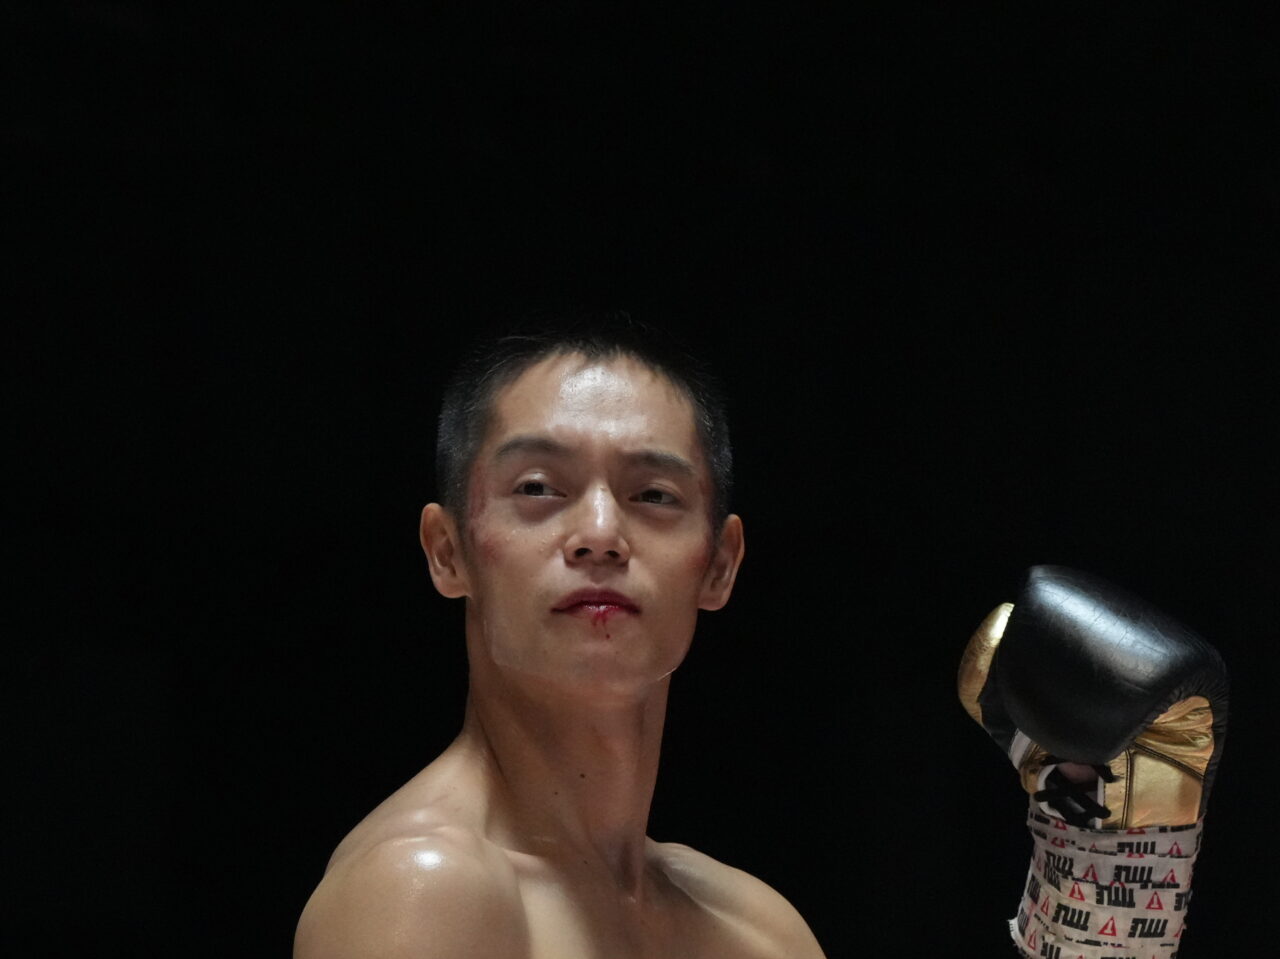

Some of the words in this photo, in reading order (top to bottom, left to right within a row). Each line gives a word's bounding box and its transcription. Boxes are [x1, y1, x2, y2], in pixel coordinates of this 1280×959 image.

[1113, 865, 1153, 883] TITLE
[1095, 883, 1136, 908] TITLE
[1052, 903, 1091, 931] TITLE
[1128, 918, 1169, 938] TITLE
